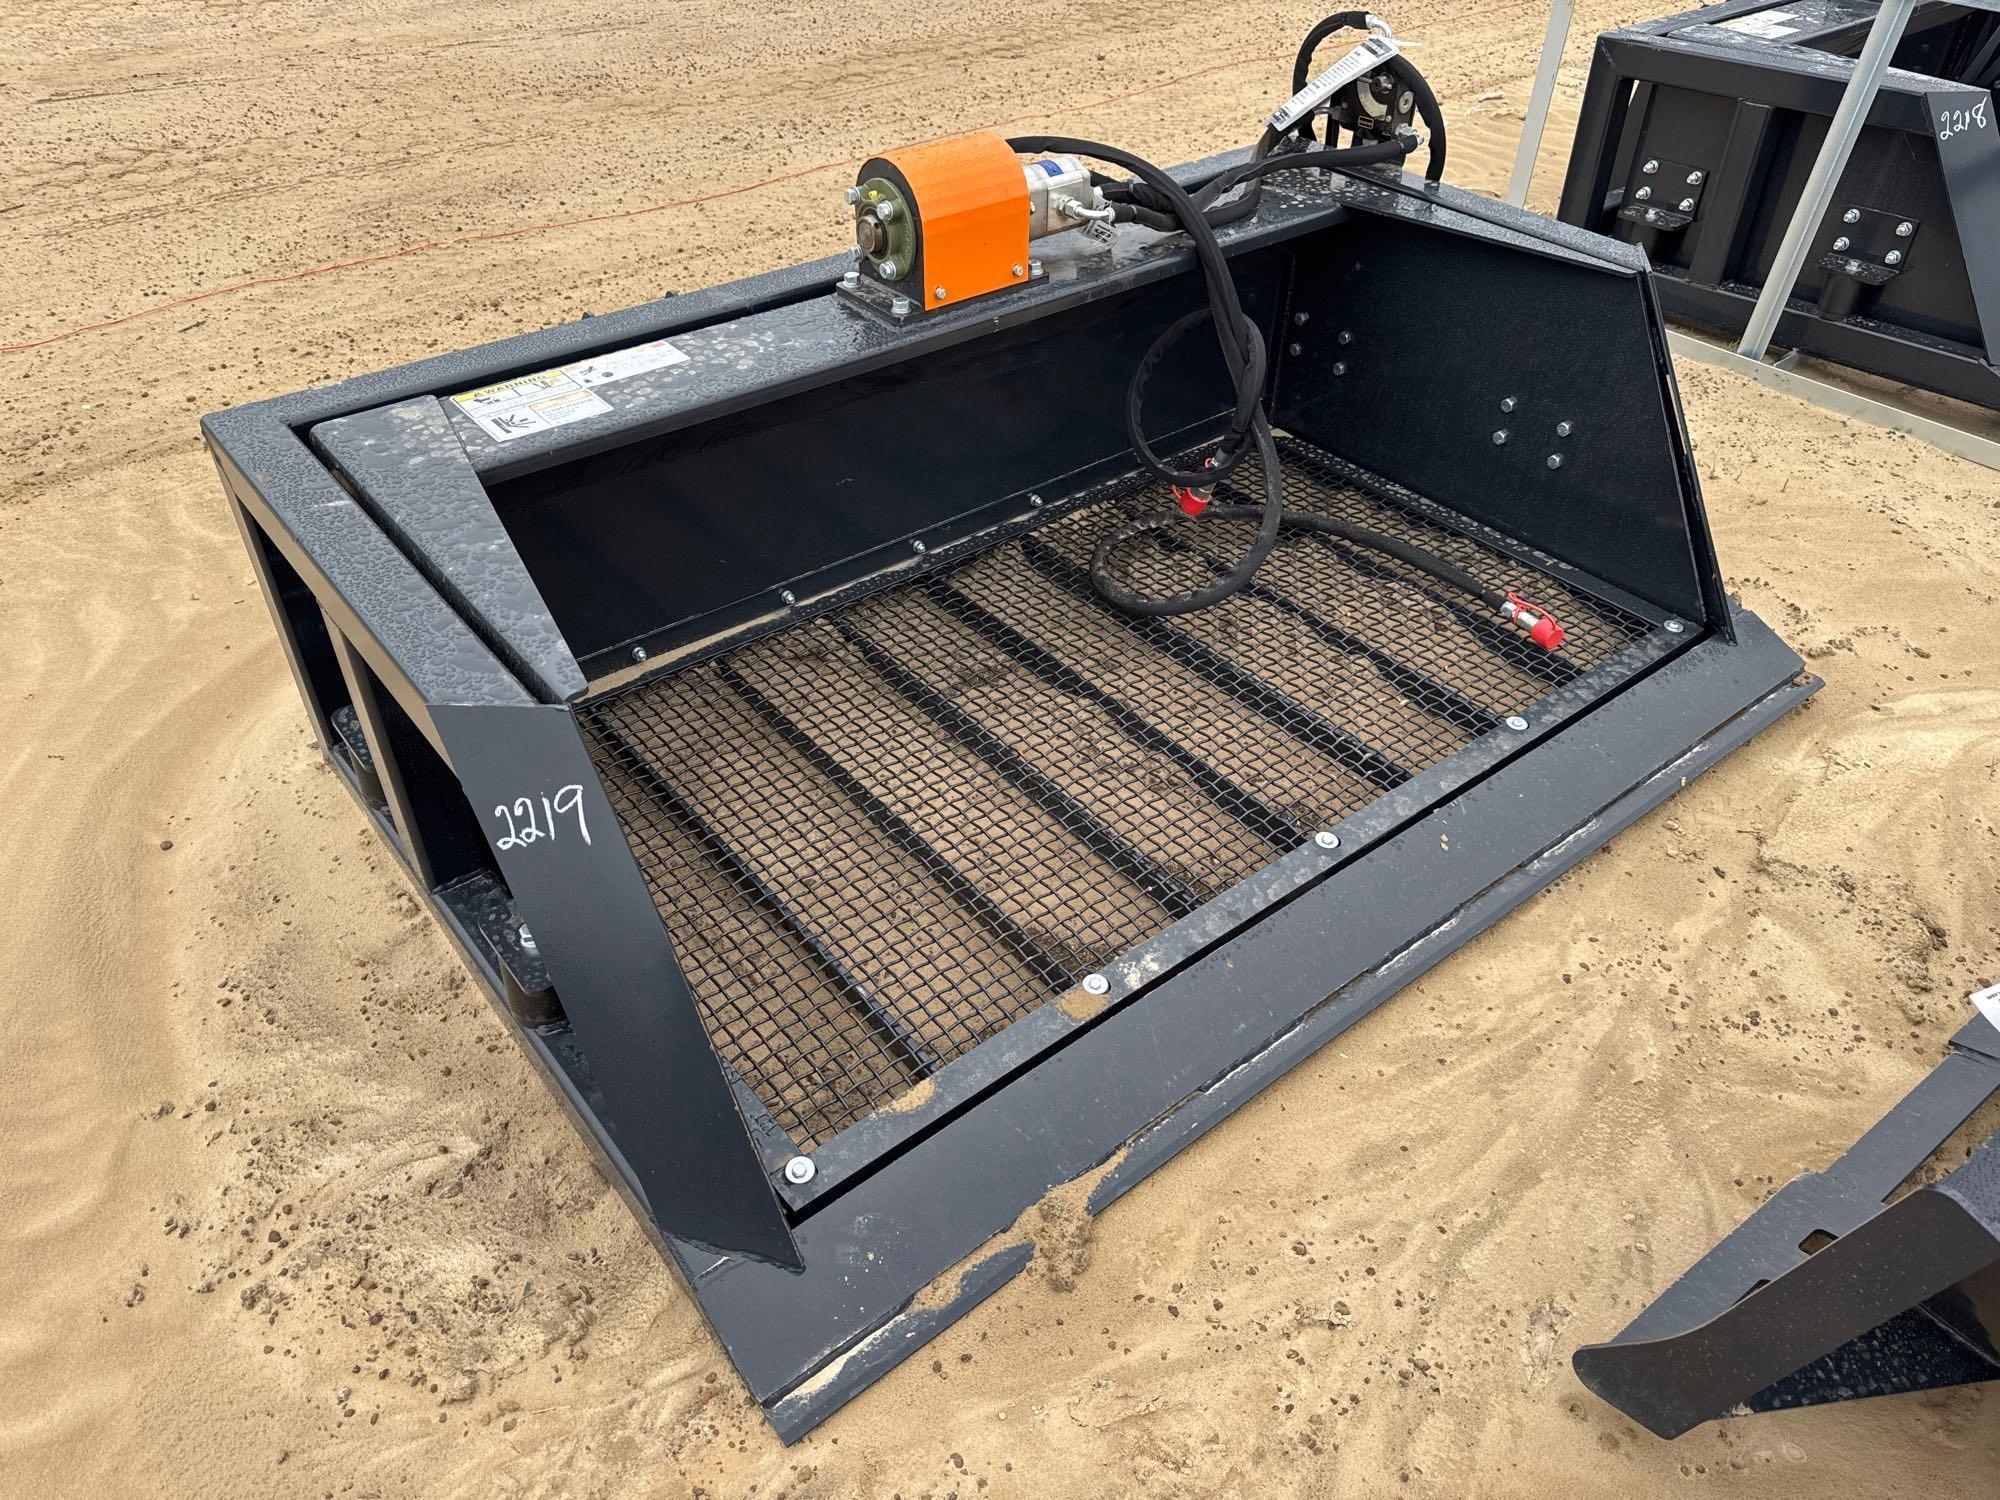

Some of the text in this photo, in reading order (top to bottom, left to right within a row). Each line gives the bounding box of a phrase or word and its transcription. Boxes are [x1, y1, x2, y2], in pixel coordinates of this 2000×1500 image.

[1940, 96, 1987, 140] 2218
[485, 375, 547, 394] WARNING
[494, 784, 591, 850] 2219
